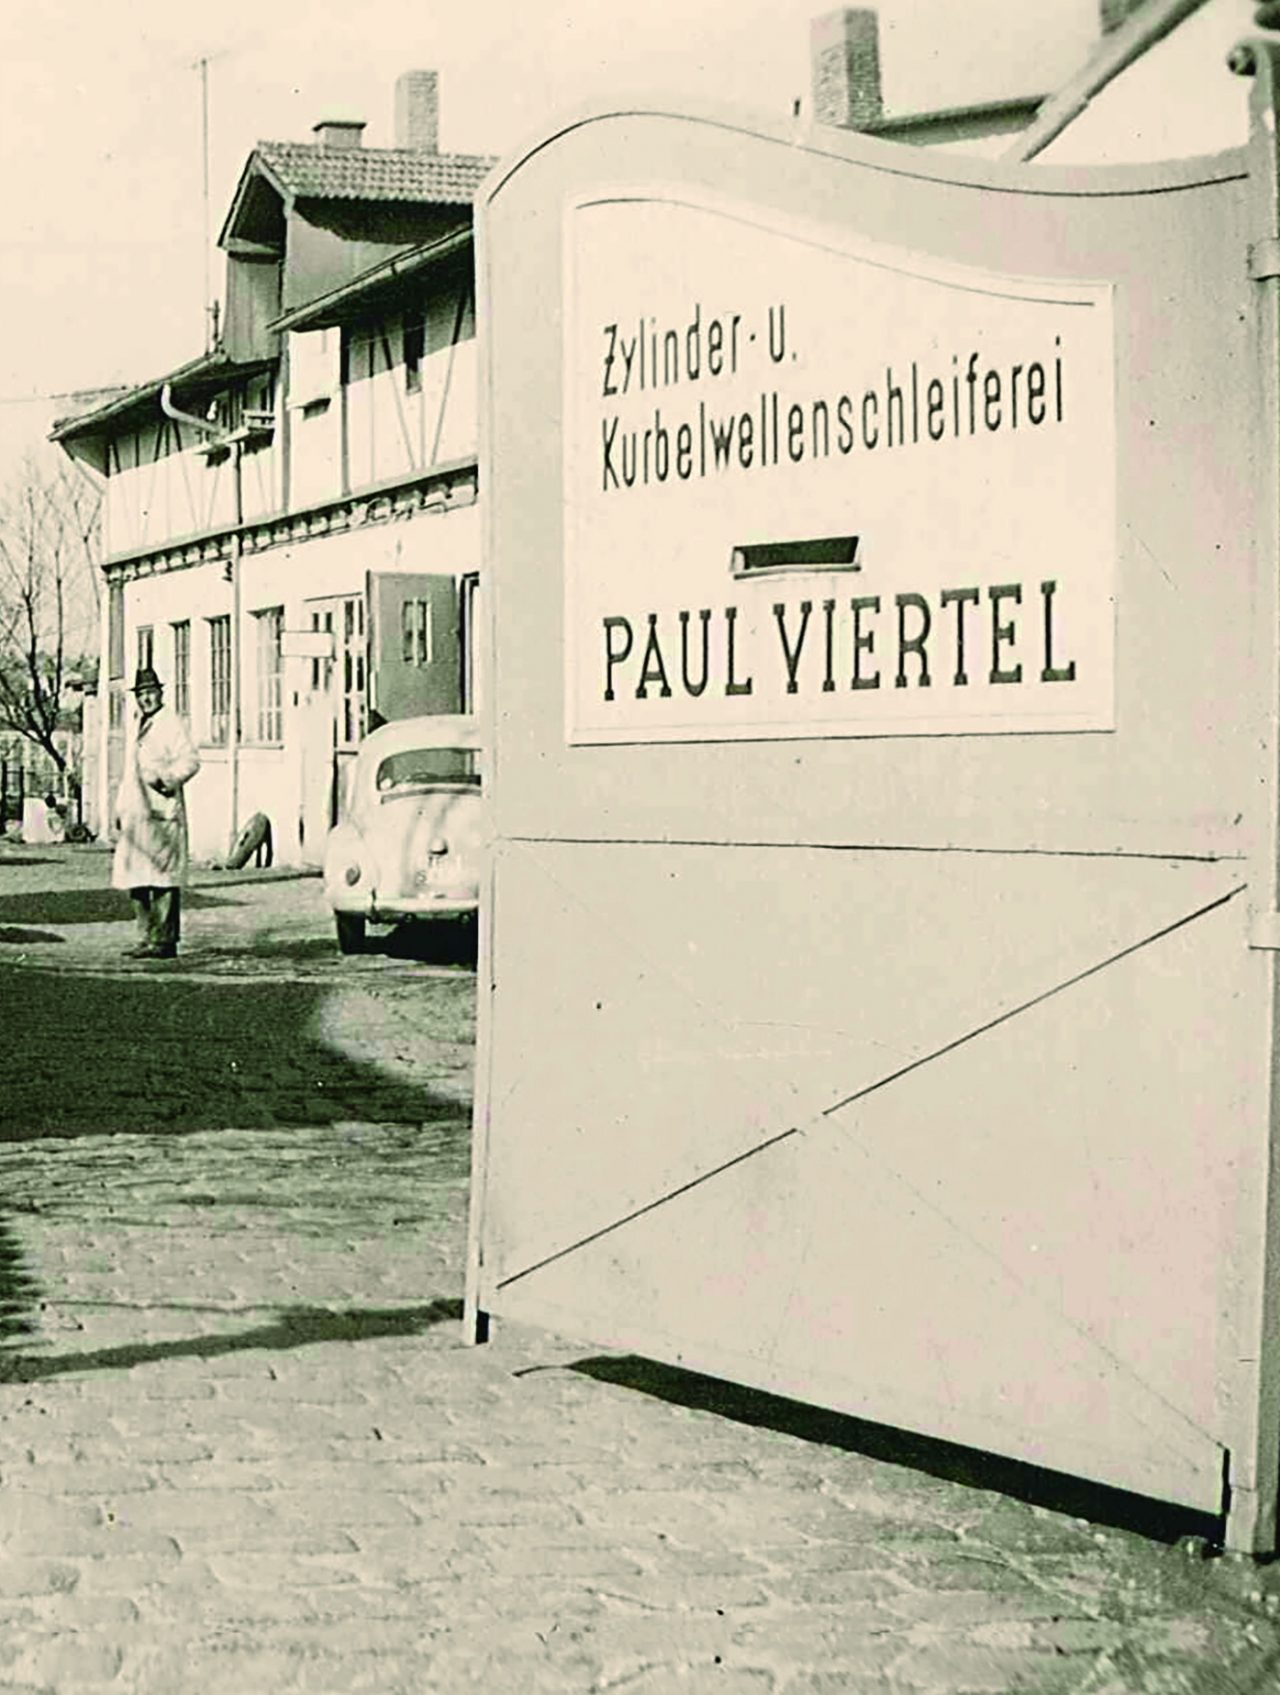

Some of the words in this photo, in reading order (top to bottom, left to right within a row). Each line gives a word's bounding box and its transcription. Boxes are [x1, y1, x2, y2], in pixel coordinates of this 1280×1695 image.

[602, 303, 756, 397] Zylinder-
[602, 335, 1062, 491] Kurbelwellenschleiferei
[603, 606, 752, 701] PAUL
[773, 580, 1076, 694] VIERTEL
